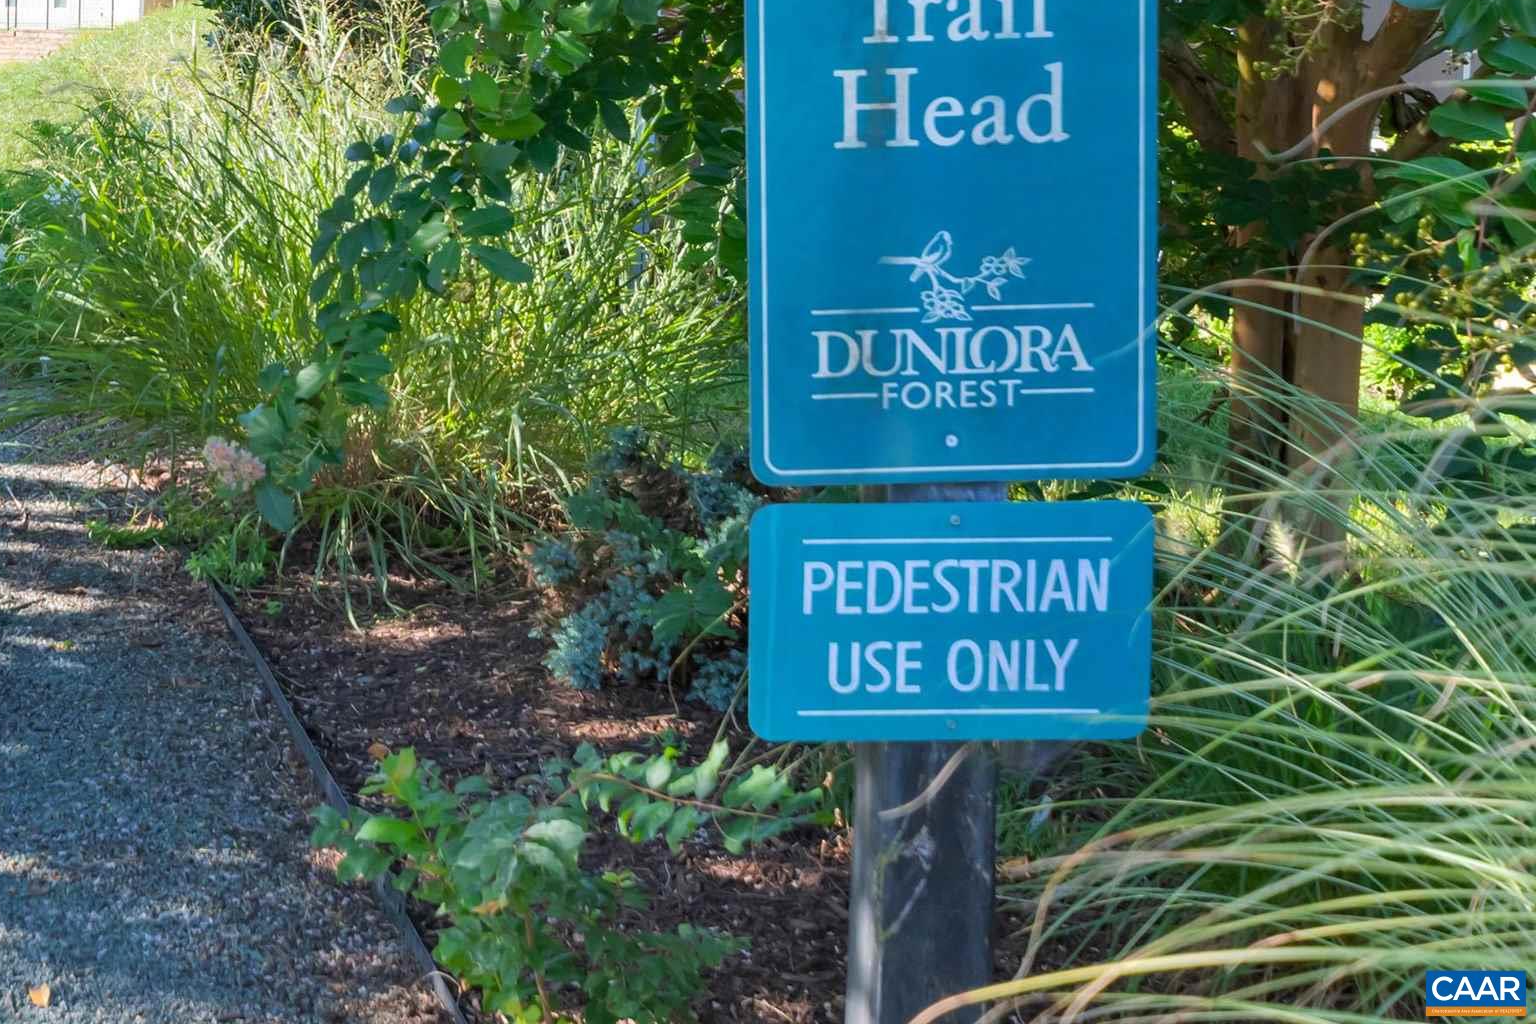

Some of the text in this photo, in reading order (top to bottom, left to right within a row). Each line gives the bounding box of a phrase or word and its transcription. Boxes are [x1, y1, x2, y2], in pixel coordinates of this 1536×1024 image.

[833, 61, 1070, 149] Head
[811, 323, 1094, 378] DUNLORA
[882, 379, 1022, 409] FOREST
[802, 558, 1110, 615] PEDESTRIAN
[828, 638, 1078, 694] USE ONLY
